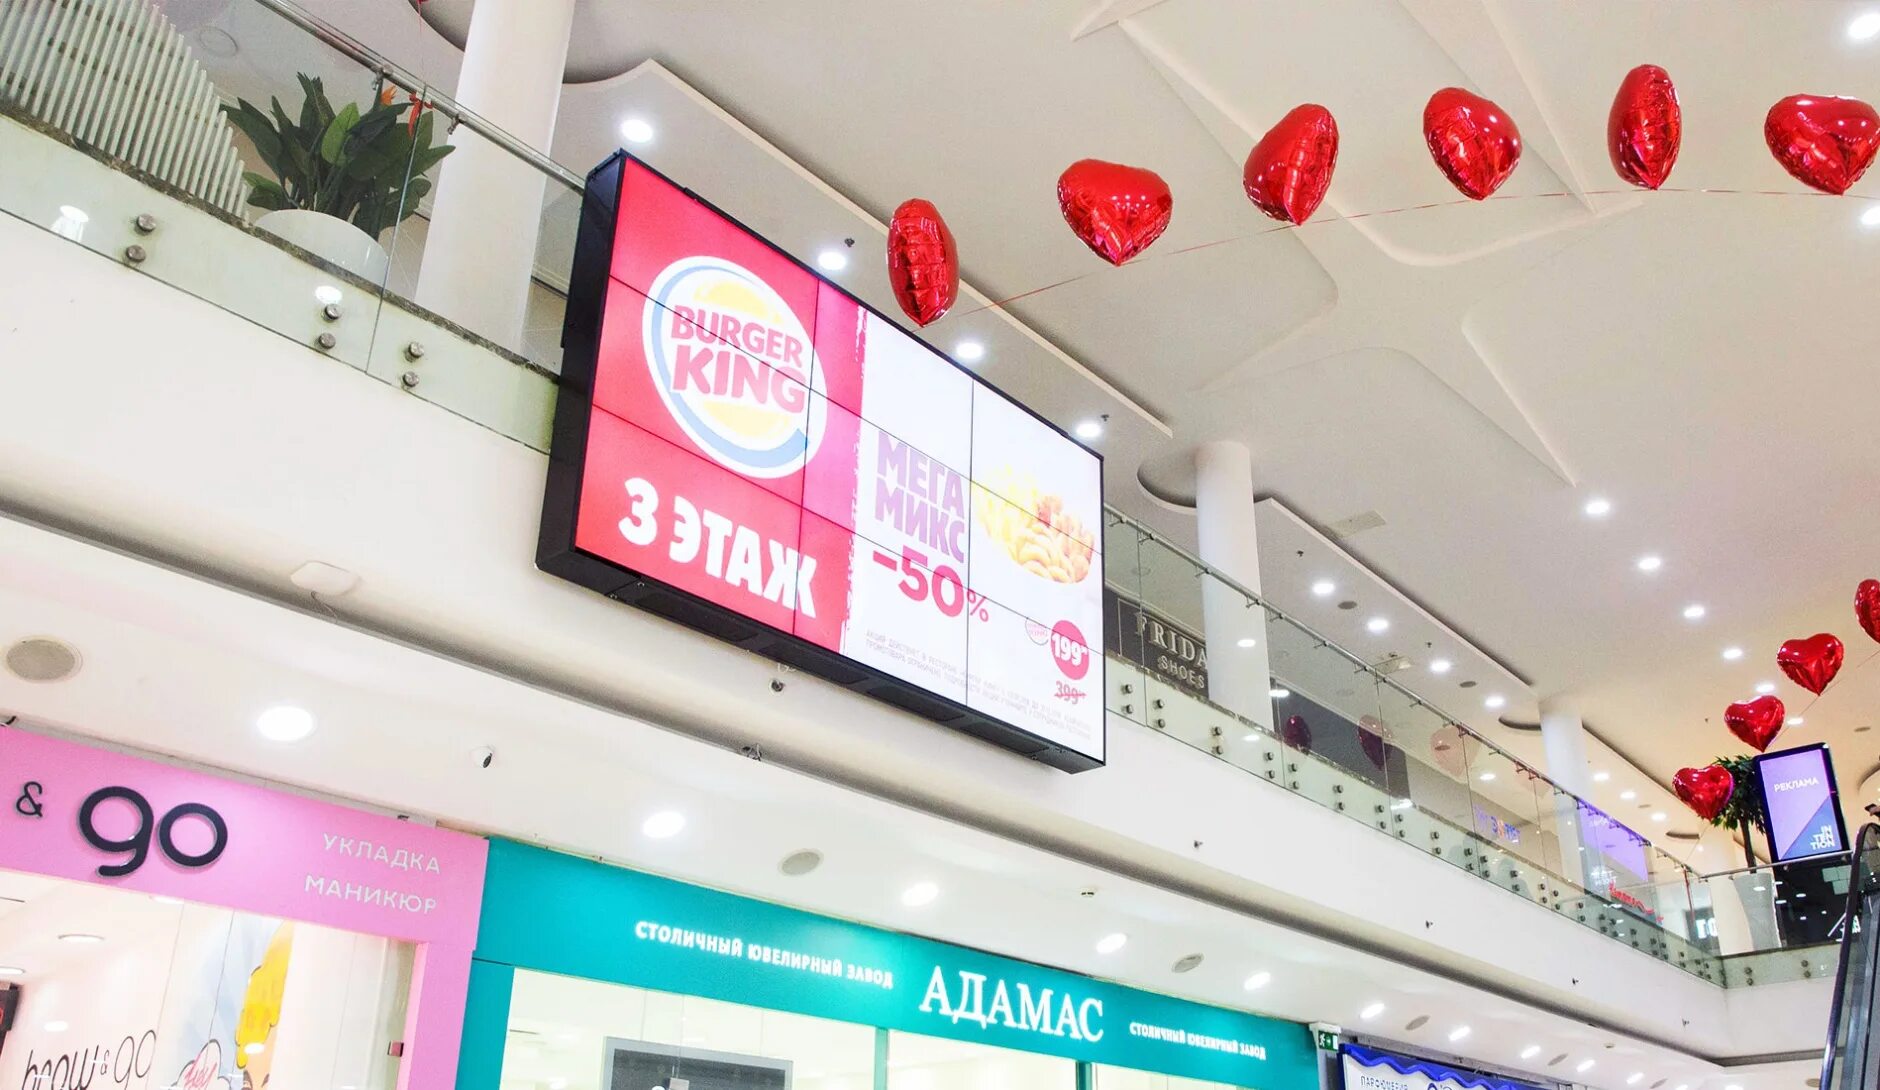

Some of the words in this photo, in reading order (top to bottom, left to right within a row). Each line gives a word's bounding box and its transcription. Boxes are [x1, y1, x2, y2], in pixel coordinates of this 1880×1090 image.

[671, 305, 803, 368] BURGER
[673, 345, 807, 414] KING
[877, 430, 965, 520] МЕГА
[618, 477, 659, 546] 3
[669, 495, 817, 619] ЭТАЖ
[875, 477, 965, 564] МИКС
[1157, 655, 1205, 689] SHOES
[1773, 777, 1820, 793] РЕКЛАМА
[16, 781, 43, 818] &
[77, 786, 228, 877] go
[323, 833, 441, 875] УКЛАДКА
[304, 875, 437, 914] МАНИКЮР
[635, 920, 743, 958] СТОЛИЧНЫЙ
[747, 943, 843, 978] ЮВЕЛИРНЫЙ
[847, 963, 894, 989] ЗАВОД
[918, 965, 1104, 1042] АДАМАС
[1129, 1021, 1186, 1044] СТОЛИЧНЫЙ
[1187, 1032, 1239, 1054] ЮВЕЛИРНЫЙ
[1240, 1042, 1267, 1061] ЗАВОД
